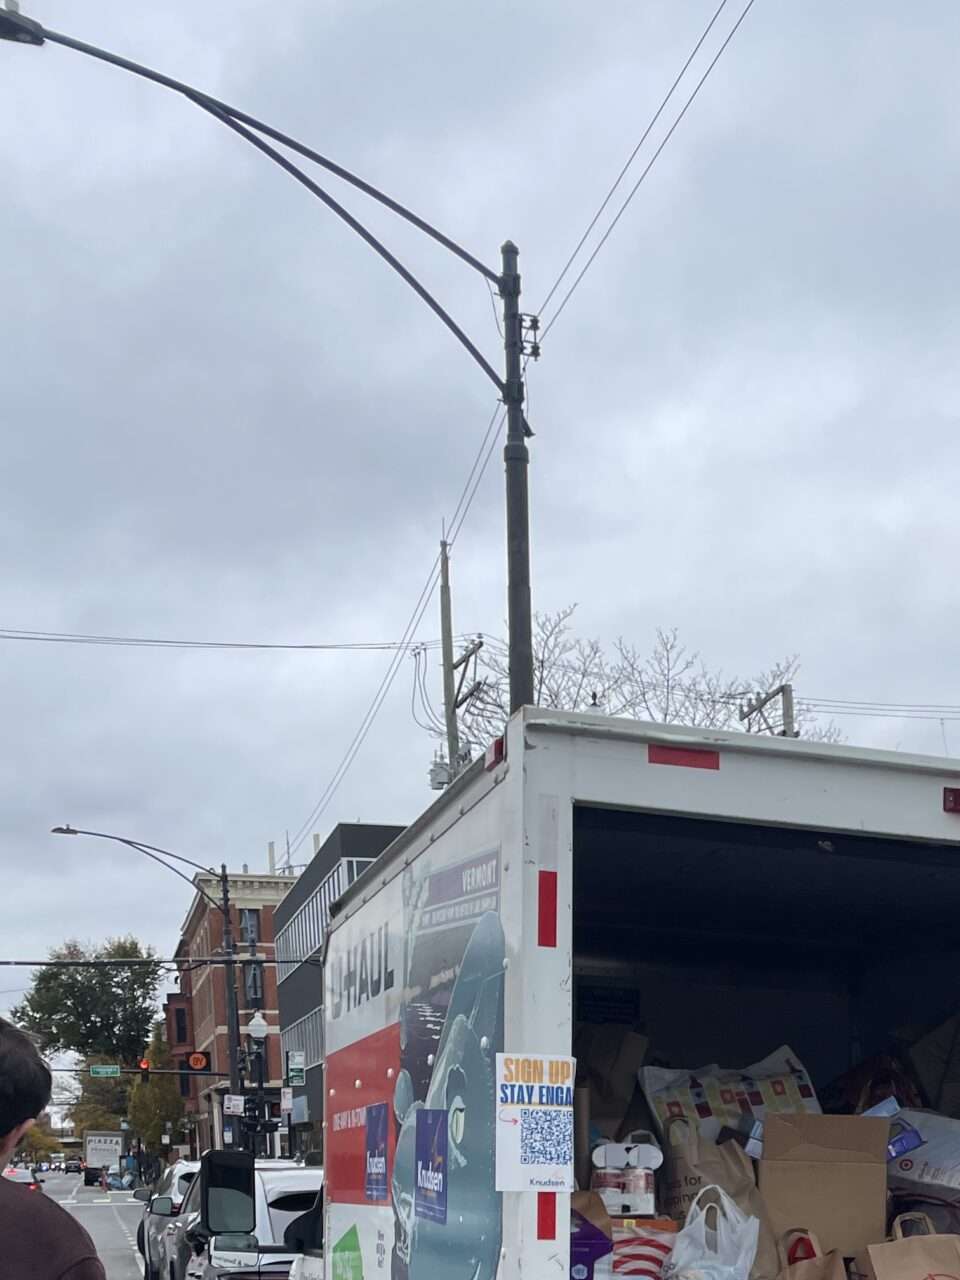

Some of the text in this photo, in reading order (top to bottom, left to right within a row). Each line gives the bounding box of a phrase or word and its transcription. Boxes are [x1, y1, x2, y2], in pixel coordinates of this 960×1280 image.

[504, 1057, 572, 1085] SIGN UP
[500, 1083, 535, 1105] STAY
[417, 1160, 443, 1193] Knudsen
[529, 1176, 566, 1188] Knudsen
